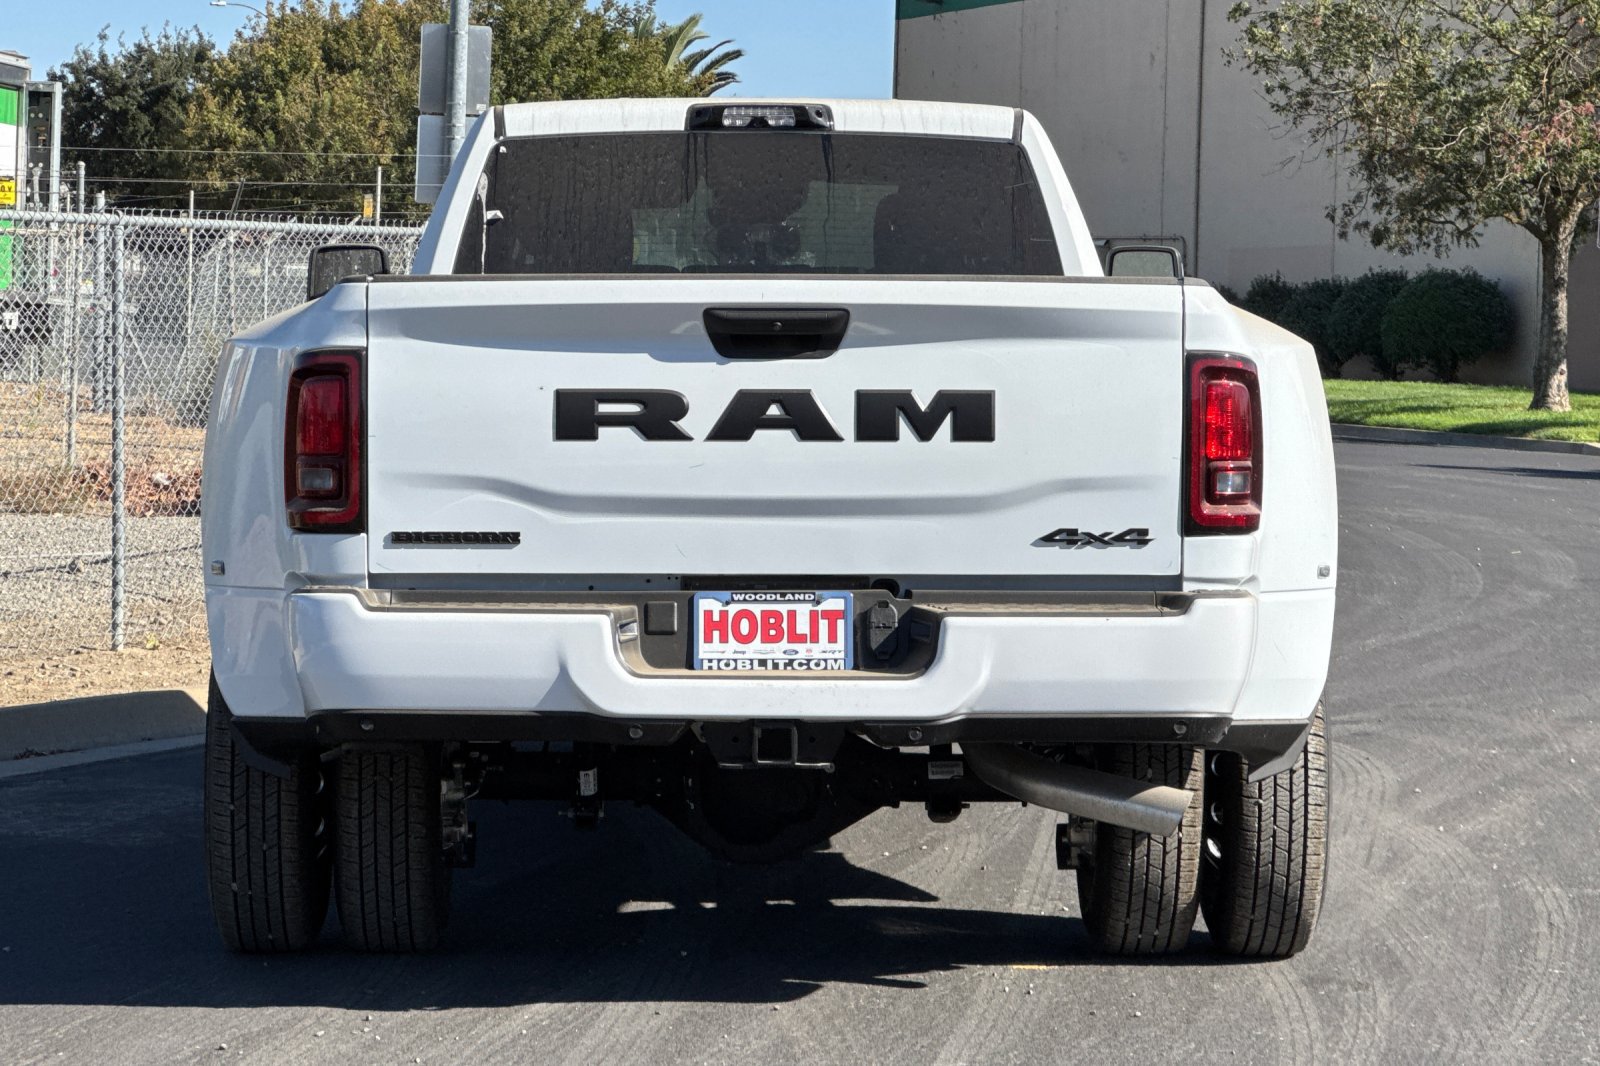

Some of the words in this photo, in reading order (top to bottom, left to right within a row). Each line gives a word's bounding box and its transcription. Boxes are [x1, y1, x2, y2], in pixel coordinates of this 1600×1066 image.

[553, 388, 996, 442] RAM
[732, 593, 815, 601] WOODLAND
[703, 609, 845, 645] HOBLIT
[702, 658, 845, 670] HOBLIT.COM
